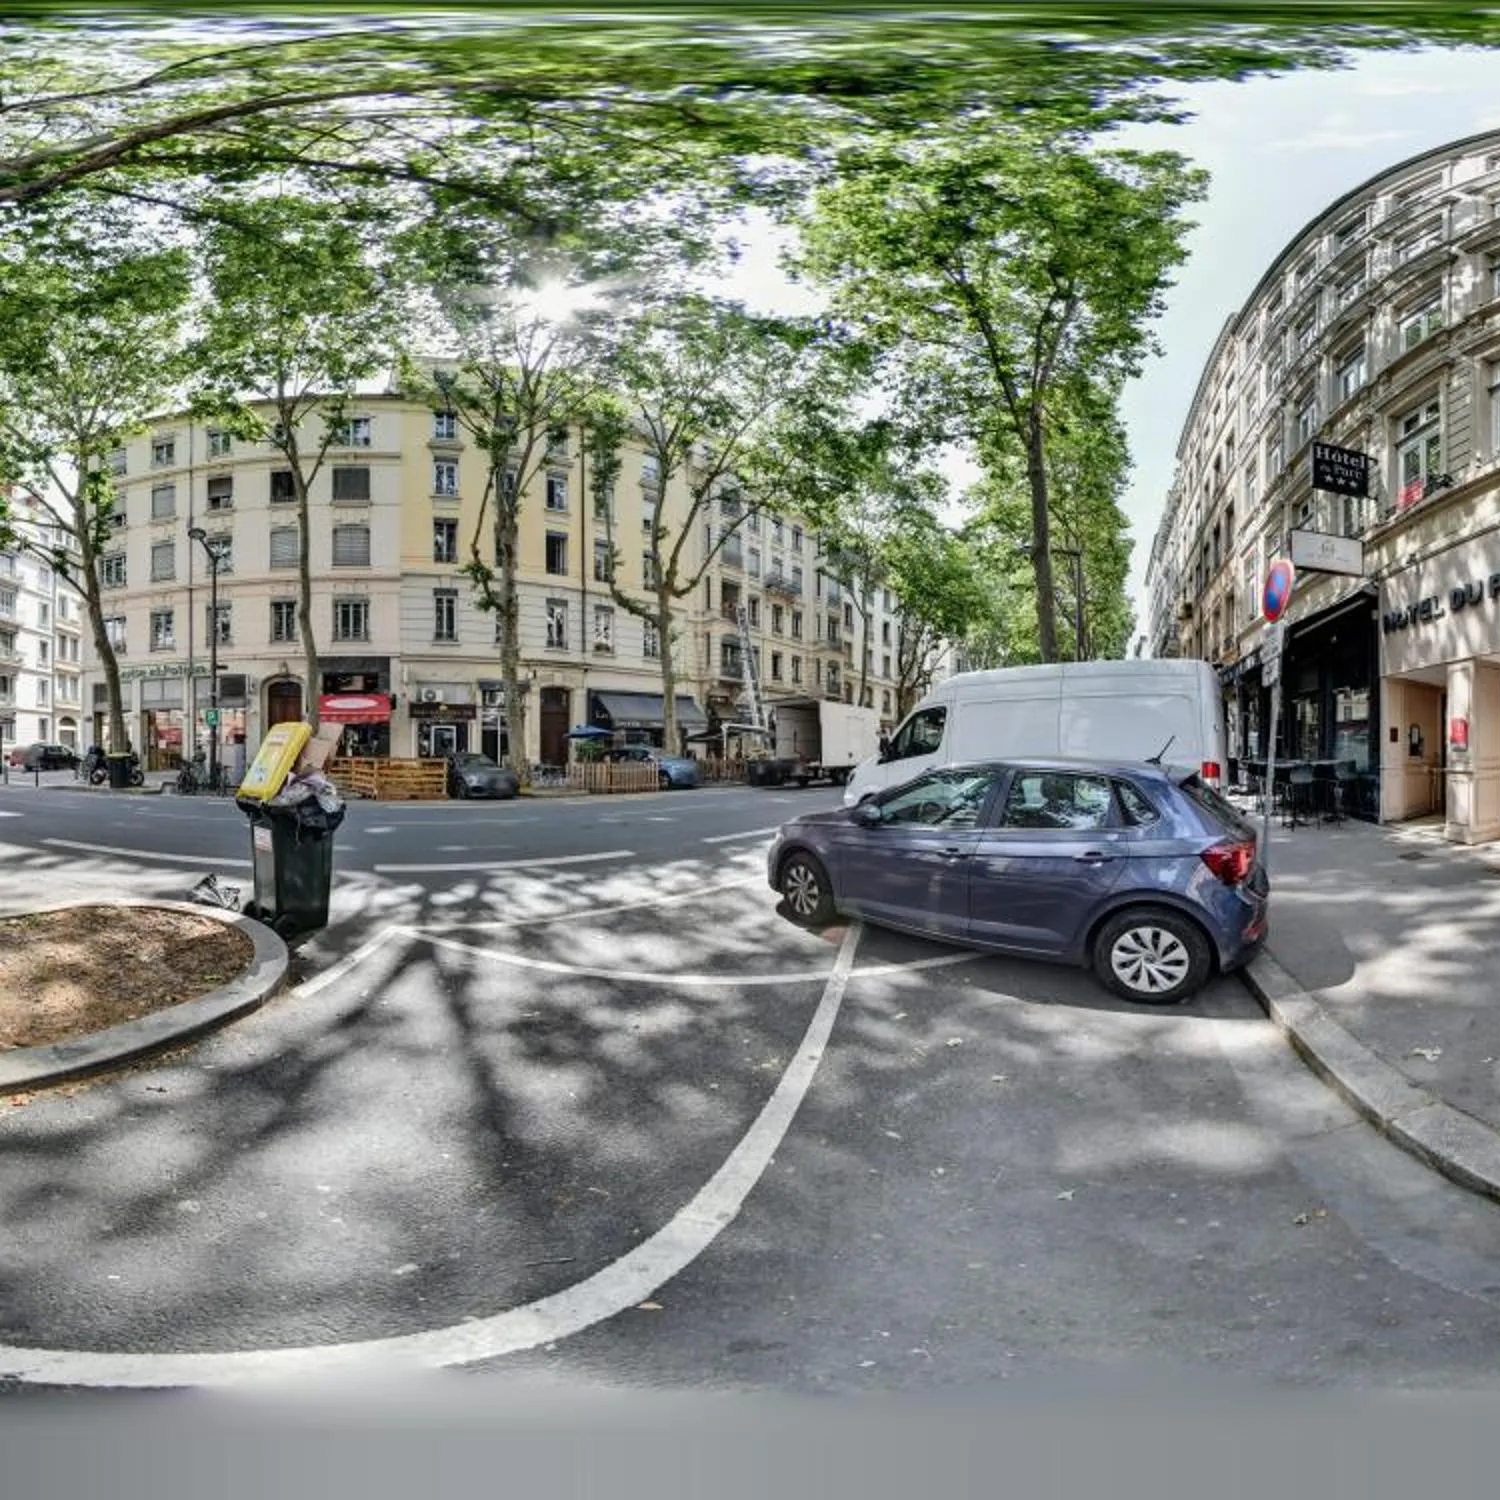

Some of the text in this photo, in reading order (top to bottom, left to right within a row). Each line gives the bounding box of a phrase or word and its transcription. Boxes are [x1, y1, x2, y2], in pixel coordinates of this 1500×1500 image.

[1315, 446, 1366, 469] Hôtel
[1333, 464, 1363, 480] Parc
[1449, 580, 1484, 611] DU
